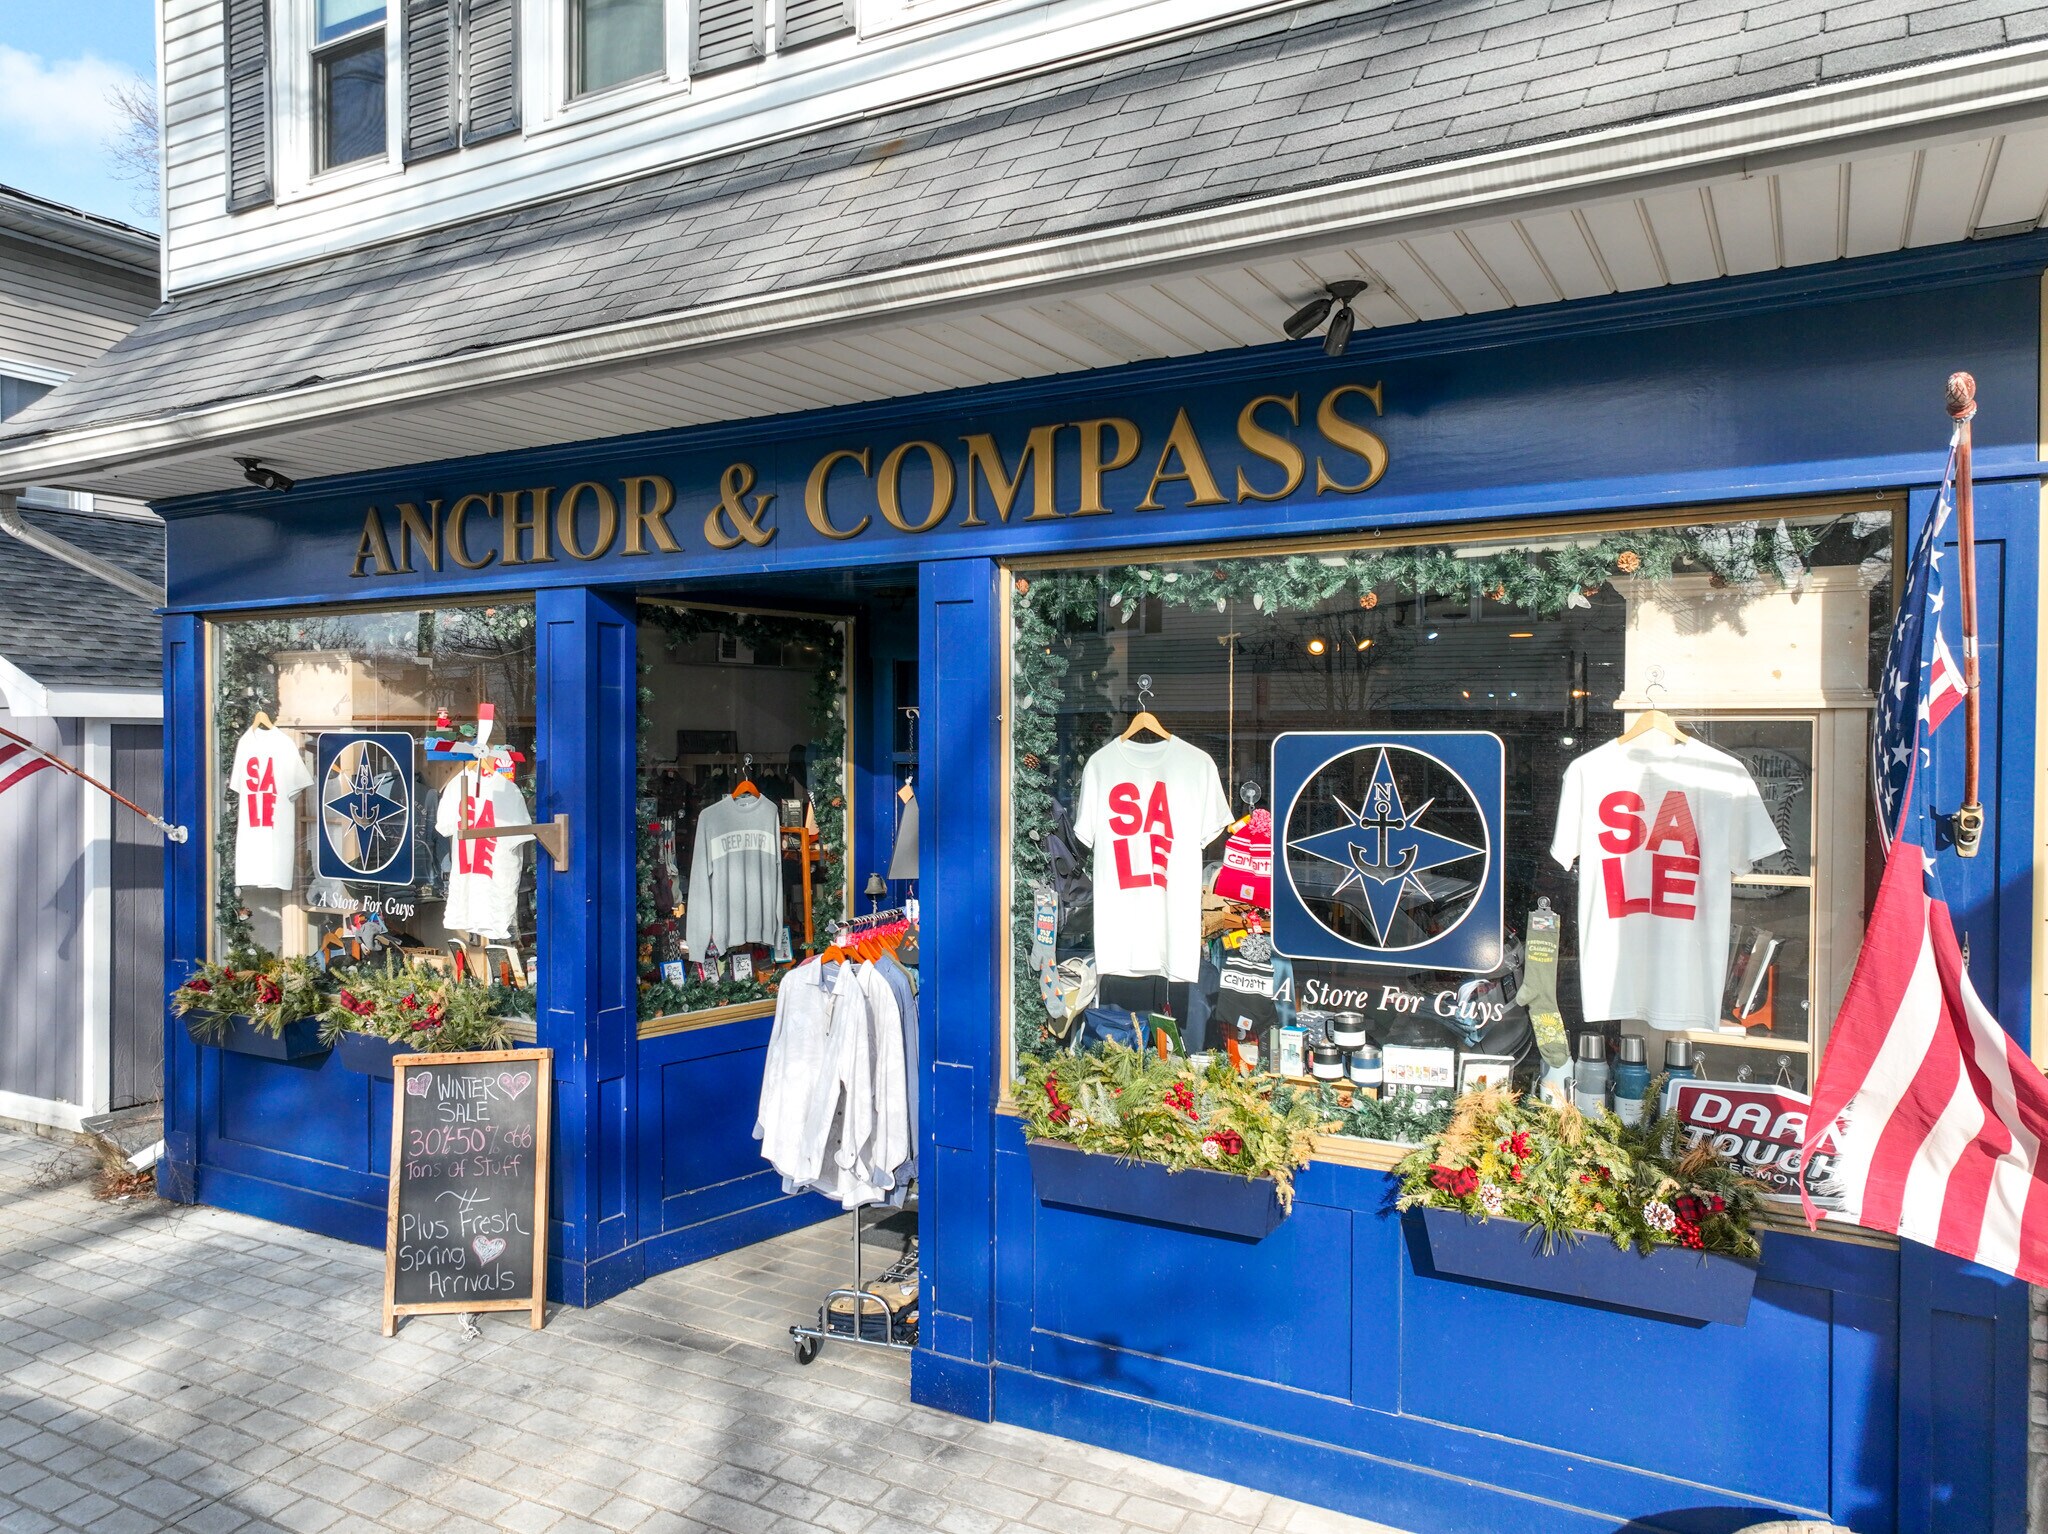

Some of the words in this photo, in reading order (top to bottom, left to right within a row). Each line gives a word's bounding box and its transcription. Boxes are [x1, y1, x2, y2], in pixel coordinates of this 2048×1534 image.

[349, 474, 684, 578] ANCHOR
[703, 461, 778, 550] &
[806, 381, 1389, 540] COMPASS
[1751, 754, 1792, 778] Strike
[721, 834, 742, 852] DEEP
[744, 833, 767, 848] RIVER
[317, 890, 327, 908] A
[331, 892, 359, 911] Store
[363, 894, 382, 913] For
[385, 897, 415, 920] Guys
[1271, 977, 1293, 1002] A
[1302, 979, 1369, 1009] Store
[1377, 984, 1425, 1013] For
[1434, 989, 1505, 1028] Guys
[437, 1074, 499, 1101] WINTER
[437, 1101, 491, 1123] SALE
[405, 1160, 442, 1180] Tons
[473, 1154, 523, 1177] Stuff
[1716, 1159, 1824, 1192] ERMONT
[401, 1213, 449, 1243] Plus
[458, 1208, 530, 1238] Fresh
[399, 1246, 466, 1272] Spring
[429, 1263, 515, 1298] Arrivals
